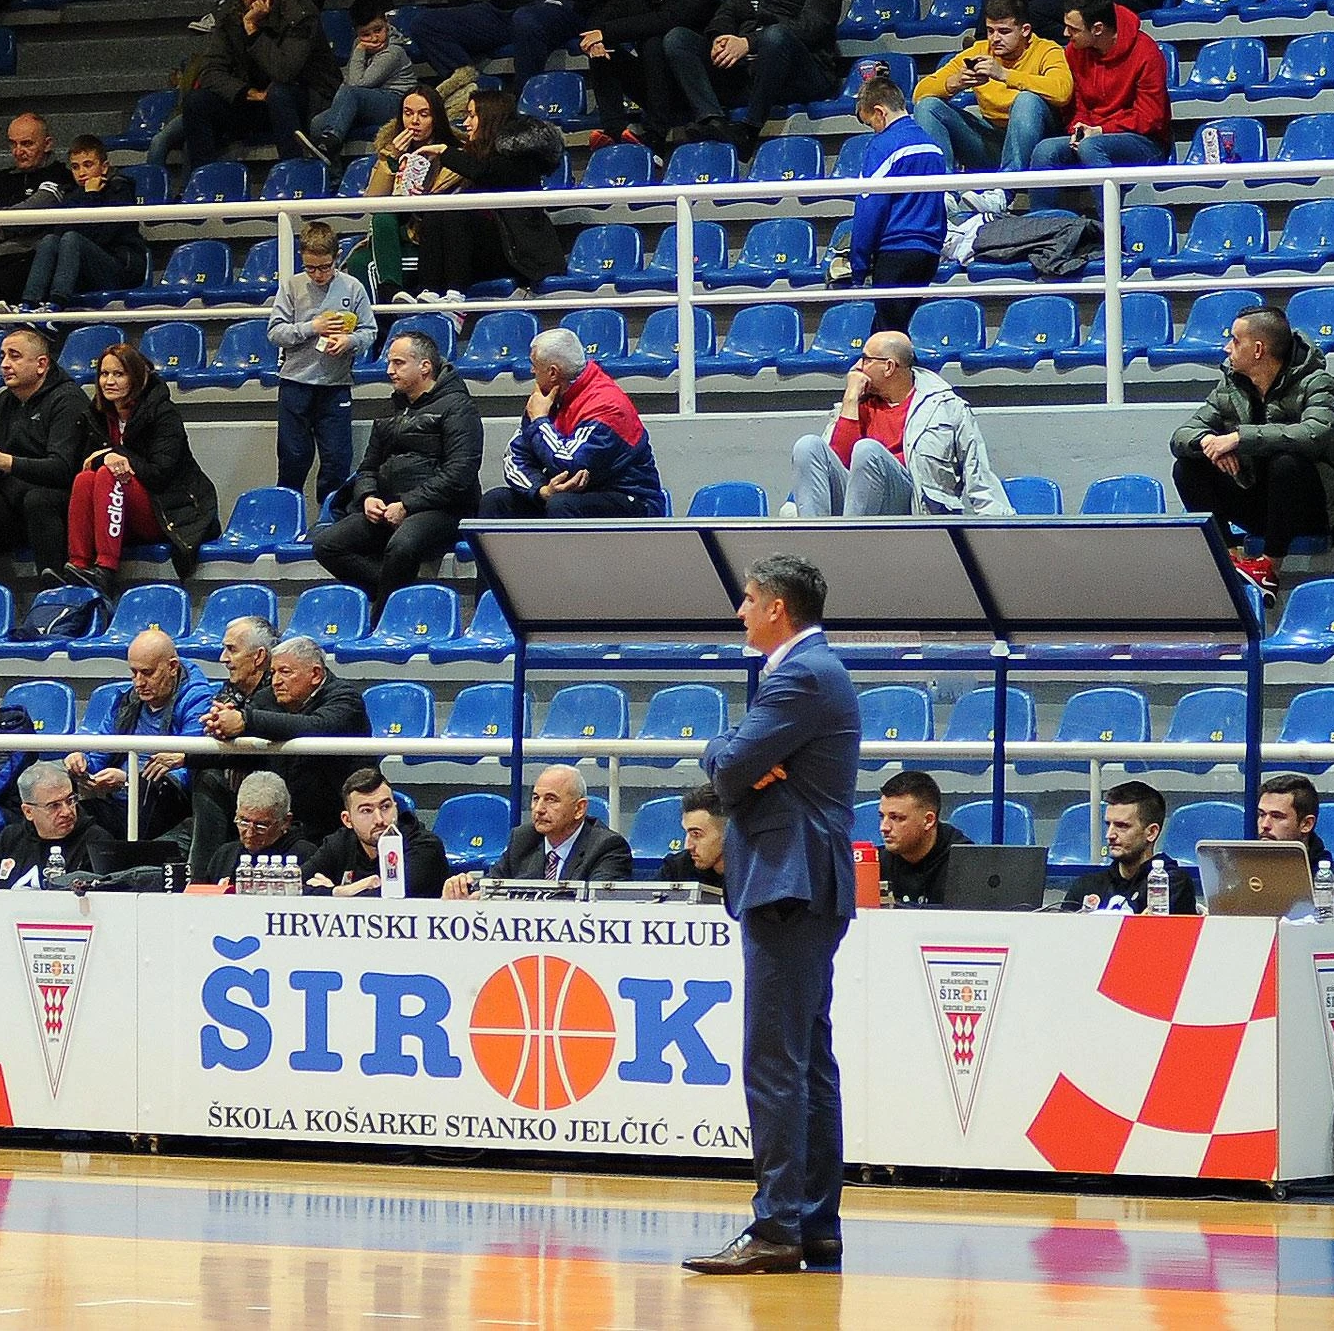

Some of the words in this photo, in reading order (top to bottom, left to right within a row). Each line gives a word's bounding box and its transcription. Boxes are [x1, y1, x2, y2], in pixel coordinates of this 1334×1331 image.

[164, 864, 174, 876] 3
[164, 877, 174, 889] 2
[265, 912, 417, 940] HRVATSKI
[427, 910, 632, 944] KOŠARKAŠKI
[641, 921, 731, 948] KLUB
[199, 935, 733, 1111] ŠIROK
[207, 1100, 297, 1132] ŠKOLA
[305, 1107, 438, 1138] KOŠARKE
[444, 1116, 557, 1143] STANKO
[564, 1115, 668, 1147] JELČIĆ
[692, 1121, 753, 1150] ĆAN
